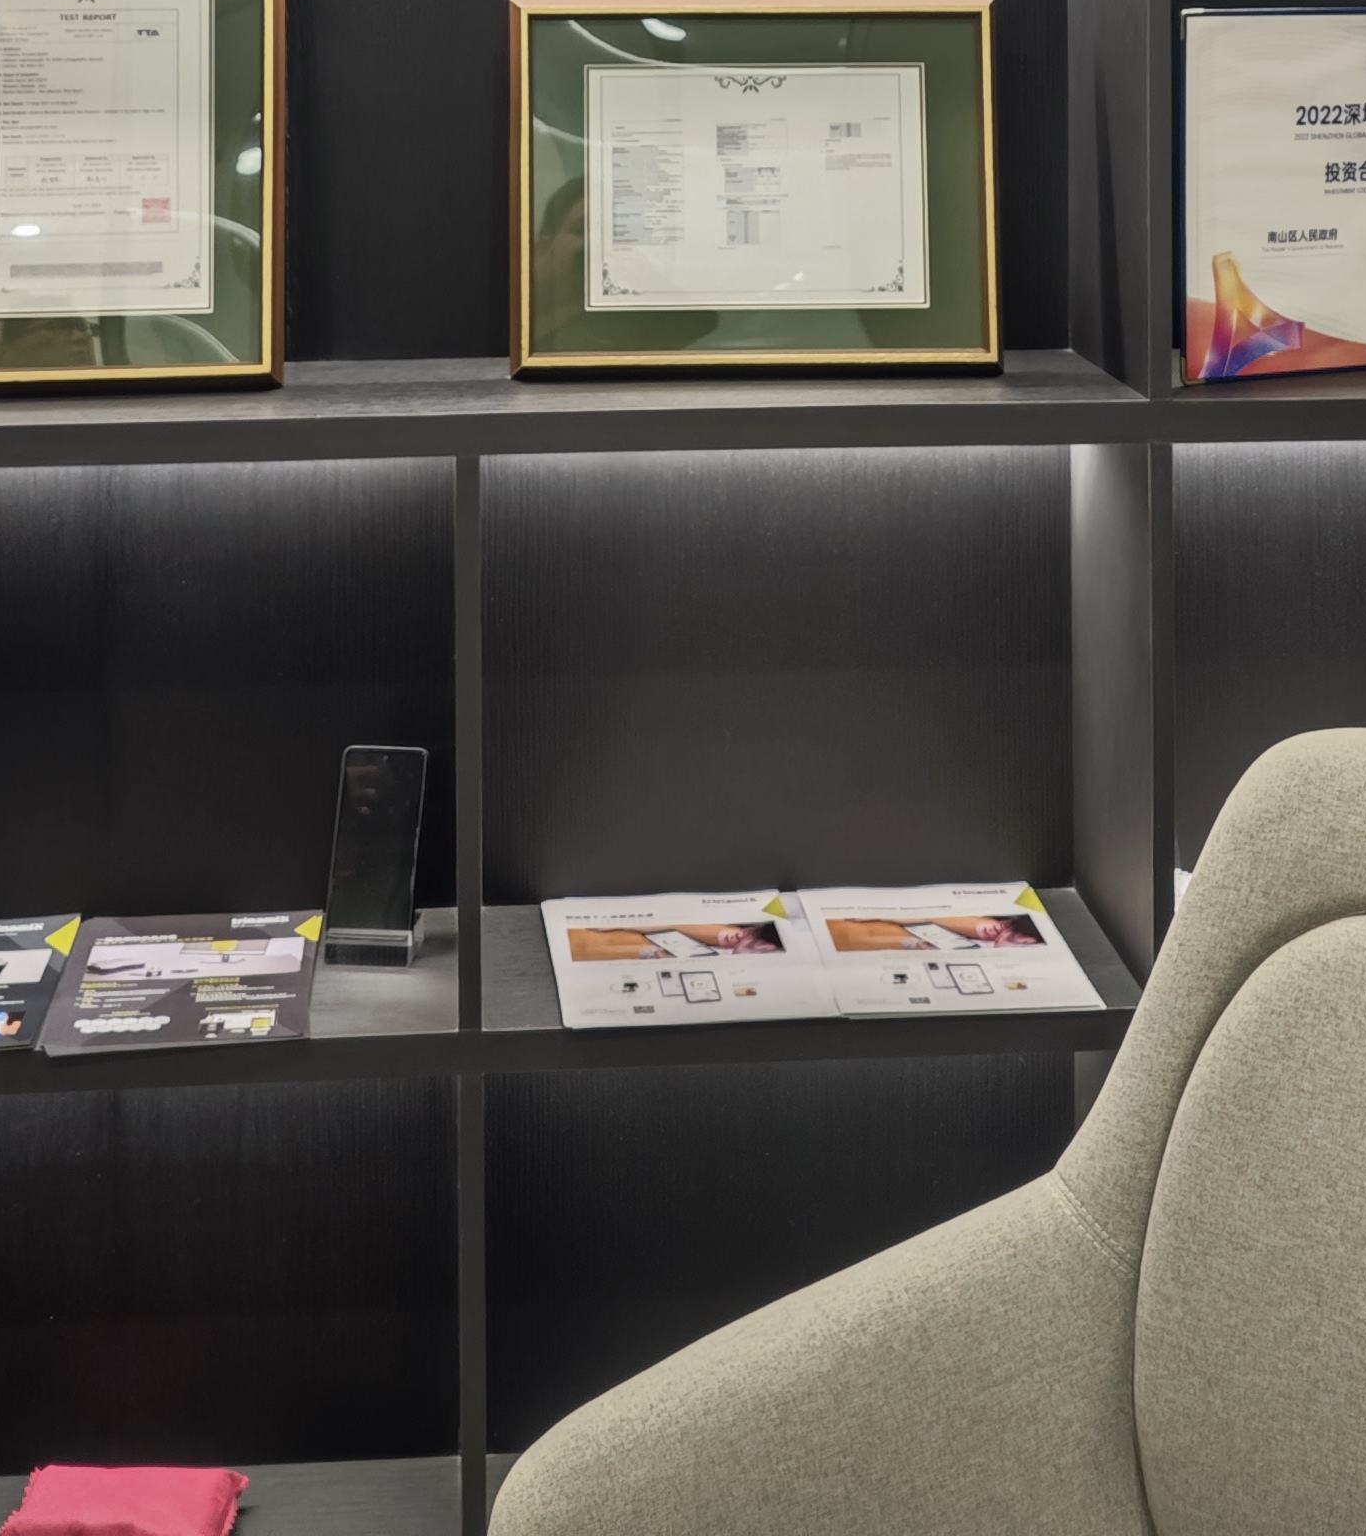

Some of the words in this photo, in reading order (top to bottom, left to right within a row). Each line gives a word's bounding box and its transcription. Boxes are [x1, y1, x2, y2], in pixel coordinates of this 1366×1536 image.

[1267, 228, 1338, 244] 南山区人民政府
